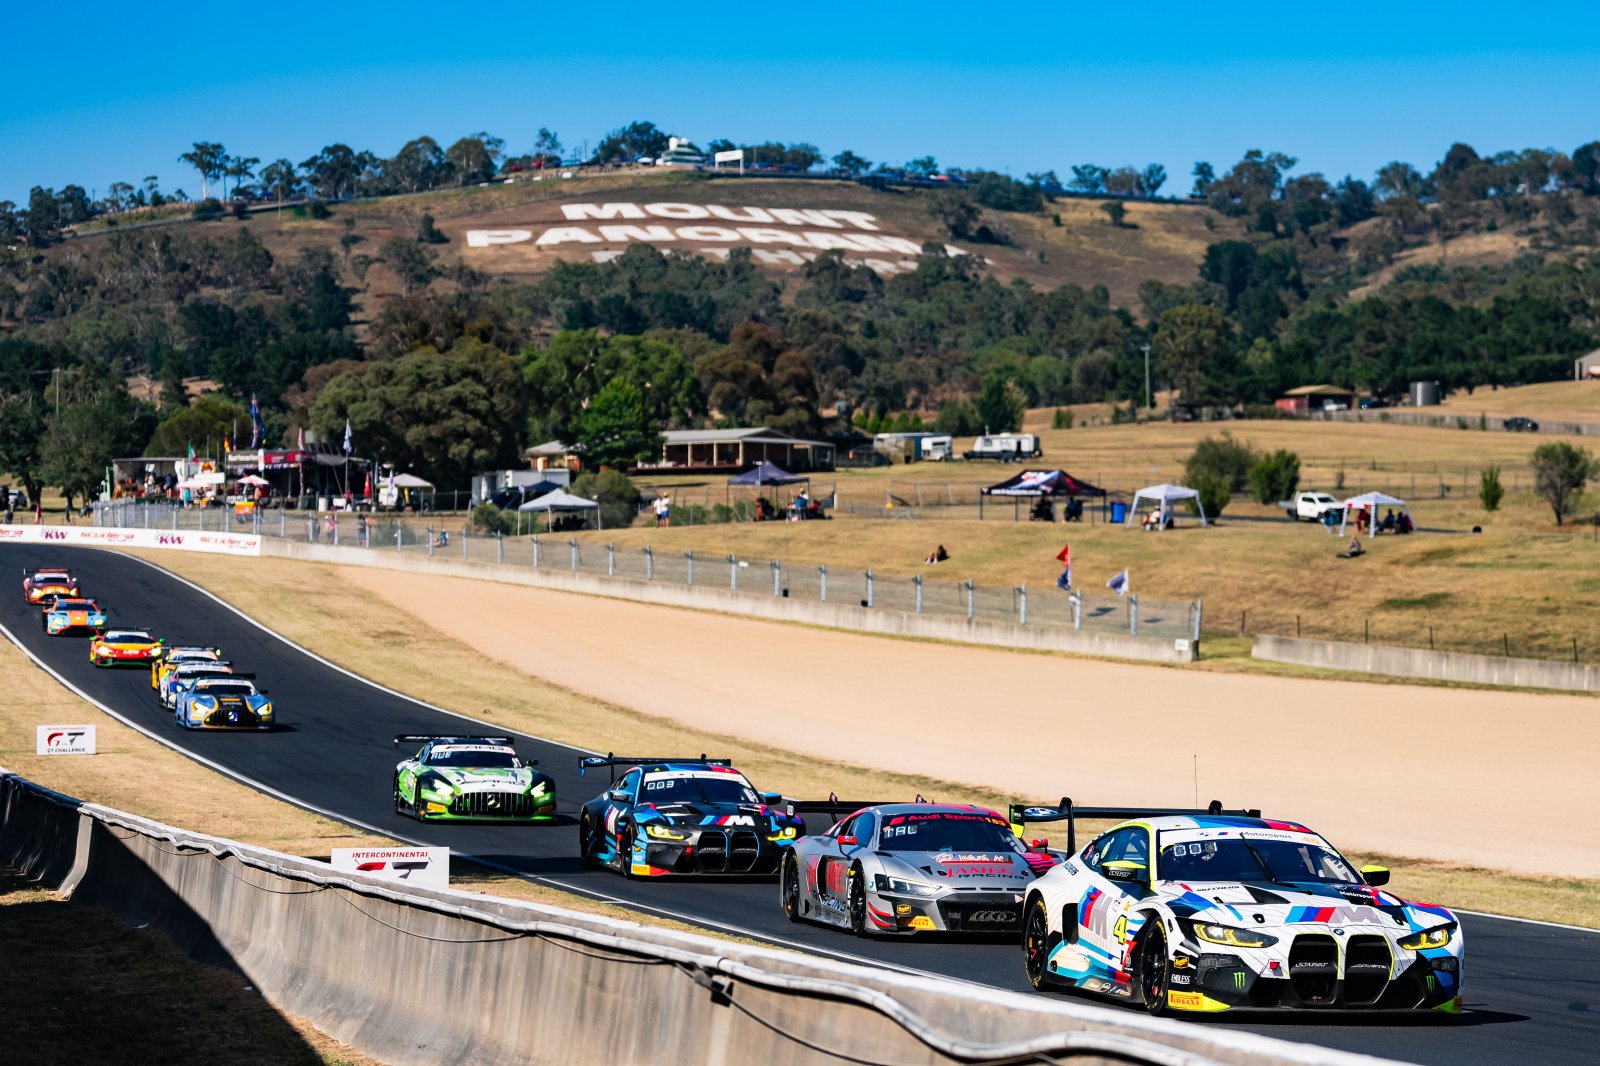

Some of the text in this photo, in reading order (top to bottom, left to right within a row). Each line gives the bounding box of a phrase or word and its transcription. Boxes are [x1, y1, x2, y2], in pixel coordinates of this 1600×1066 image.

[561, 202, 880, 231] MOUNT
[45, 531, 67, 539] KW
[159, 535, 184, 544] KW
[908, 814, 941, 822] Audi
[943, 813, 985, 822] Sport
[1242, 831, 1293, 839] Motorsport
[948, 867, 1014, 878] JAMEC
[1171, 993, 1199, 1005] PIRELLI
